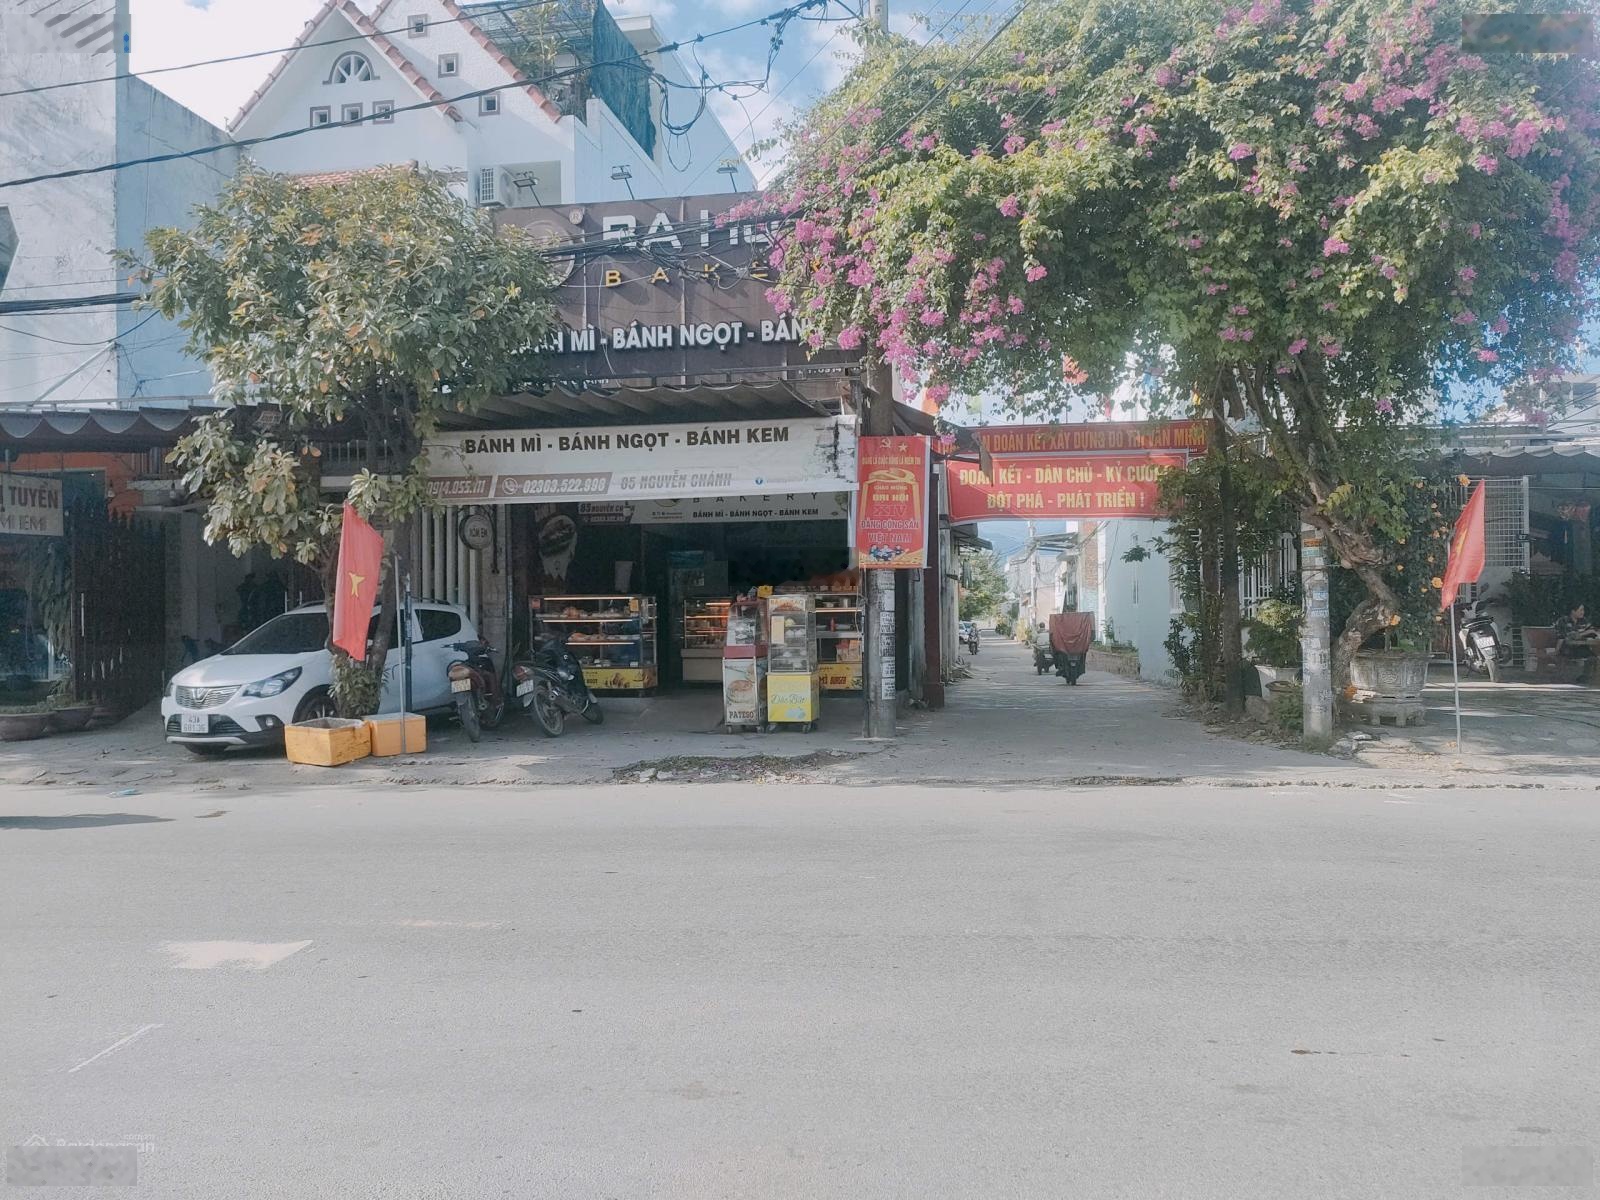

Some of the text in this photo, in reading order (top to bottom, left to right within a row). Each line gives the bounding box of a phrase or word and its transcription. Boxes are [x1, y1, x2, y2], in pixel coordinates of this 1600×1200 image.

[571, 323, 596, 352] MÌ
[613, 318, 673, 350] BÁNH
[680, 321, 742, 352] NGỌT
[761, 313, 808, 342] BÁN
[465, 434, 515, 454] BÁNH
[521, 433, 542, 452] MÌ
[558, 431, 610, 451] BÁNH
[616, 431, 670, 452] NGỌT
[686, 426, 741, 446] BÁNH
[747, 427, 789, 444] KEM
[999, 463, 1023, 484] KẾT
[1035, 463, 1064, 483] DÂN
[1066, 461, 1092, 483] CHỦ
[1105, 460, 1126, 483] KỶ
[987, 490, 1012, 511] ĐỘT
[1016, 490, 1044, 509] PHÁ
[1057, 489, 1092, 508] PHÁT
[1095, 486, 1136, 508] TRIỂN
